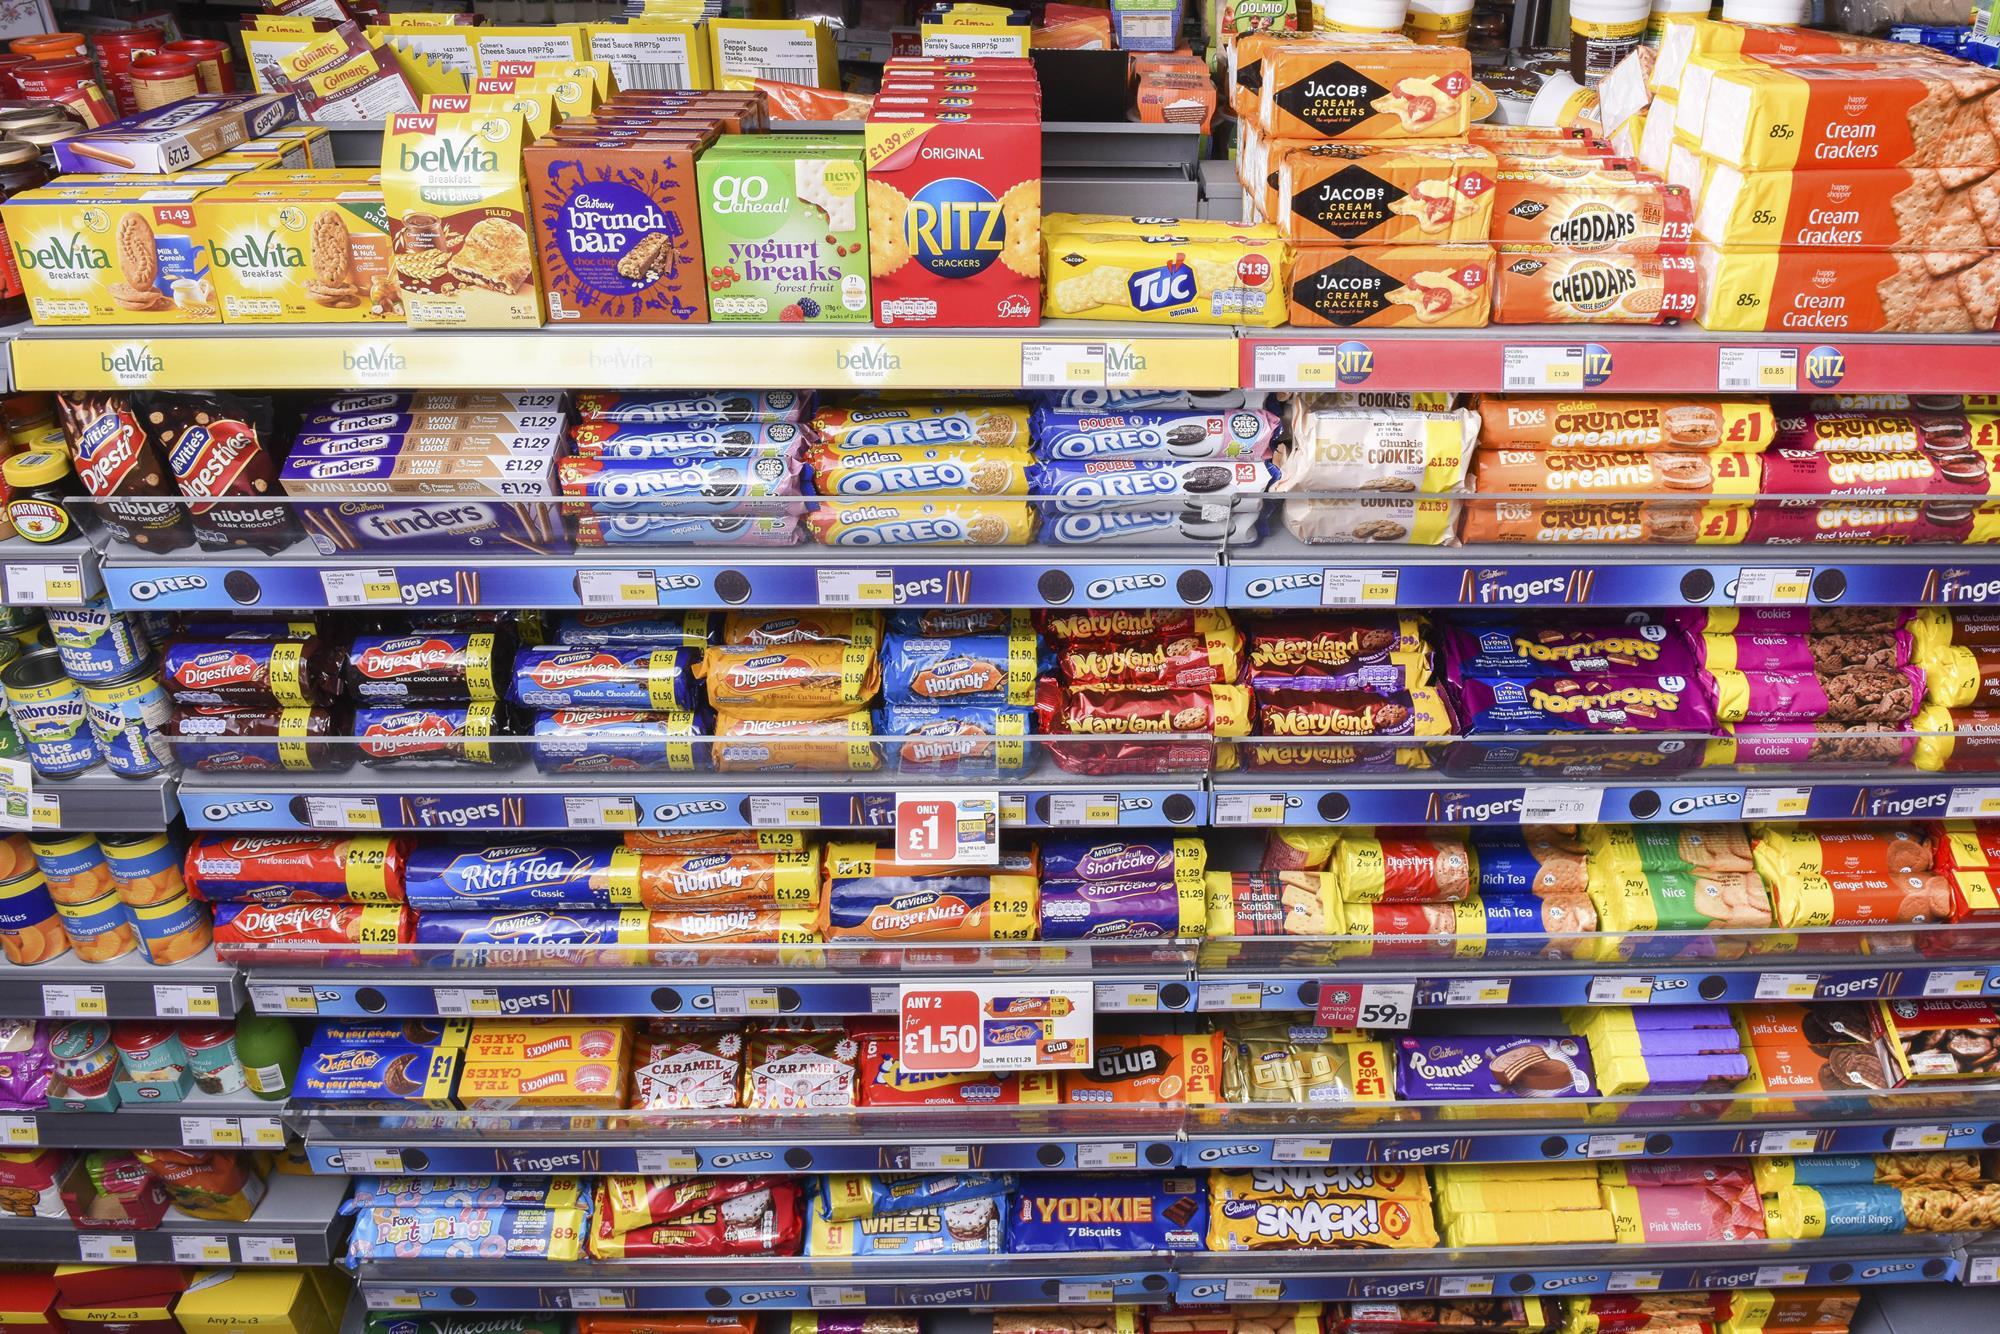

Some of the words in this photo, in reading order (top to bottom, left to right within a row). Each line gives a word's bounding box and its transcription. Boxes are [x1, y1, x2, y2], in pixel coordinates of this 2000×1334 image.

[1241, 2, 1282, 14] DOLMIO
[724, 44, 746, 53] Pepper
[293, 42, 339, 72] Colman's
[501, 65, 532, 74] NEW
[323, 65, 370, 90] Colman's
[325, 91, 346, 101] CHILLI
[346, 85, 358, 93] CON
[359, 75, 378, 87] CARNE
[1447, 78, 1462, 90] £1
[1315, 99, 1355, 108] CREAM
[1848, 96, 1866, 104] happy
[1303, 108, 1365, 116] CRACKERS
[1844, 104, 1868, 112] shopper
[396, 118, 432, 129] NEW
[1770, 125, 1794, 139] 85p
[1826, 122, 1875, 138] Cream
[870, 133, 900, 160] £1.39
[902, 128, 915, 140] RRP
[400, 135, 498, 172] belVita
[922, 148, 984, 160] ORIGINAL
[1815, 143, 1878, 159] Crackers
[428, 176, 472, 184] Breakfast
[824, 171, 858, 182] new
[712, 175, 769, 214] go
[575, 194, 614, 210] Cadbury
[732, 199, 789, 213] ahead!
[159, 210, 189, 221] £1.49
[568, 206, 666, 229] brunch
[907, 201, 1005, 256] RITZ
[568, 230, 626, 252] bar
[14, 231, 112, 269] belVita
[728, 239, 819, 264] yogurt
[931, 259, 980, 268] CRACKERS
[1239, 263, 1271, 275] £1.39
[49, 270, 90, 280] Breakfast
[744, 261, 841, 282] breaks
[776, 283, 806, 293] forest
[809, 283, 834, 293] fruit
[1553, 268, 1636, 302] CHEDDARS
[1662, 294, 1695, 309] £1.39
[999, 300, 1032, 317] Bakery
[1170, 306, 1198, 316] ORIGINAL
[1806, 356, 1844, 378] RITZ
[1557, 402, 1597, 411] Golden
[1080, 417, 1124, 430] DOUBLE
[1728, 412, 1760, 441] £1
[1379, 439, 1422, 448] Chunkie
[1552, 428, 1661, 447] creams
[843, 453, 900, 467] Golden
[1368, 450, 1423, 464] COOKIES
[1428, 458, 1459, 467] £1.39
[506, 460, 542, 470] £1.29
[840, 465, 962, 494] OREO
[11, 505, 54, 515] MARMITE
[210, 506, 284, 521] nibbles
[340, 502, 384, 515] Cadbury
[240, 517, 286, 528] CHOCOLATE
[1816, 532, 1836, 540] Red
[1838, 530, 1871, 538] Velvet
[131, 576, 207, 600] OREO
[1087, 574, 1166, 599] OREO
[1965, 624, 2000, 632] Digestives
[272, 651, 295, 660] £1.50
[185, 666, 251, 683] Digestives
[37, 689, 52, 698] £1
[1216, 716, 1234, 726] 99p
[1271, 706, 1373, 734] Maryland
[39, 743, 72, 754] Rice
[33, 748, 92, 768] Pudding
[917, 805, 939, 814] ONLY
[1559, 803, 1584, 811] £1.00
[909, 816, 938, 850] £1
[1087, 854, 1155, 874] Shortcake
[1388, 856, 1433, 867] Digestives
[462, 865, 516, 891] Rich
[520, 858, 563, 879] Tea
[531, 890, 565, 898] Classic
[1239, 893, 1250, 901] All
[1252, 893, 1277, 901] Butter
[1662, 888, 1686, 897] Nice
[994, 901, 1028, 912] £1.29
[1242, 902, 1274, 910] Scottish
[872, 911, 925, 930] Ginger
[927, 904, 964, 921] Nuts
[1237, 911, 1282, 921] Shortbread
[362, 929, 396, 941] £1.29
[907, 998, 931, 1008] ANY
[934, 998, 942, 1008] 2
[1322, 1006, 1356, 1015] amazing
[1322, 1012, 1353, 1021] value
[1362, 1004, 1407, 1025] 59p
[906, 1016, 920, 1026] for
[905, 1025, 977, 1054] £1.50
[526, 1040, 569, 1057] TUNNOCK'S
[1099, 1051, 1156, 1076] CLUB
[1358, 1052, 1375, 1067] 6
[1410, 1052, 1482, 1079] Roundie
[432, 1057, 452, 1078] £1
[652, 1061, 724, 1074] CARAMEL
[1254, 1056, 1332, 1083] GOLD
[1359, 1068, 1378, 1077] FOR
[1133, 1077, 1160, 1087] Orange
[1769, 1076, 1789, 1086] Jaffa
[1792, 1075, 1813, 1084] Cakes
[1356, 1079, 1385, 1095] £1
[1036, 1197, 1152, 1222] YORKIE
[861, 1216, 941, 1234] WHEELS
[1257, 1200, 1379, 1242] SNACK!
[1803, 1216, 1820, 1226] 85p
[1831, 1215, 1864, 1224] Coconut
[1867, 1215, 1892, 1224] Rings
[1078, 1227, 1121, 1236] Biscuits
[1650, 1222, 1668, 1231] Pink
[1670, 1222, 1702, 1230] Wafers
[554, 1228, 578, 1240] 89p
[1861, 1263, 1916, 1278] OREO
[87, 1311, 108, 1320] Any
